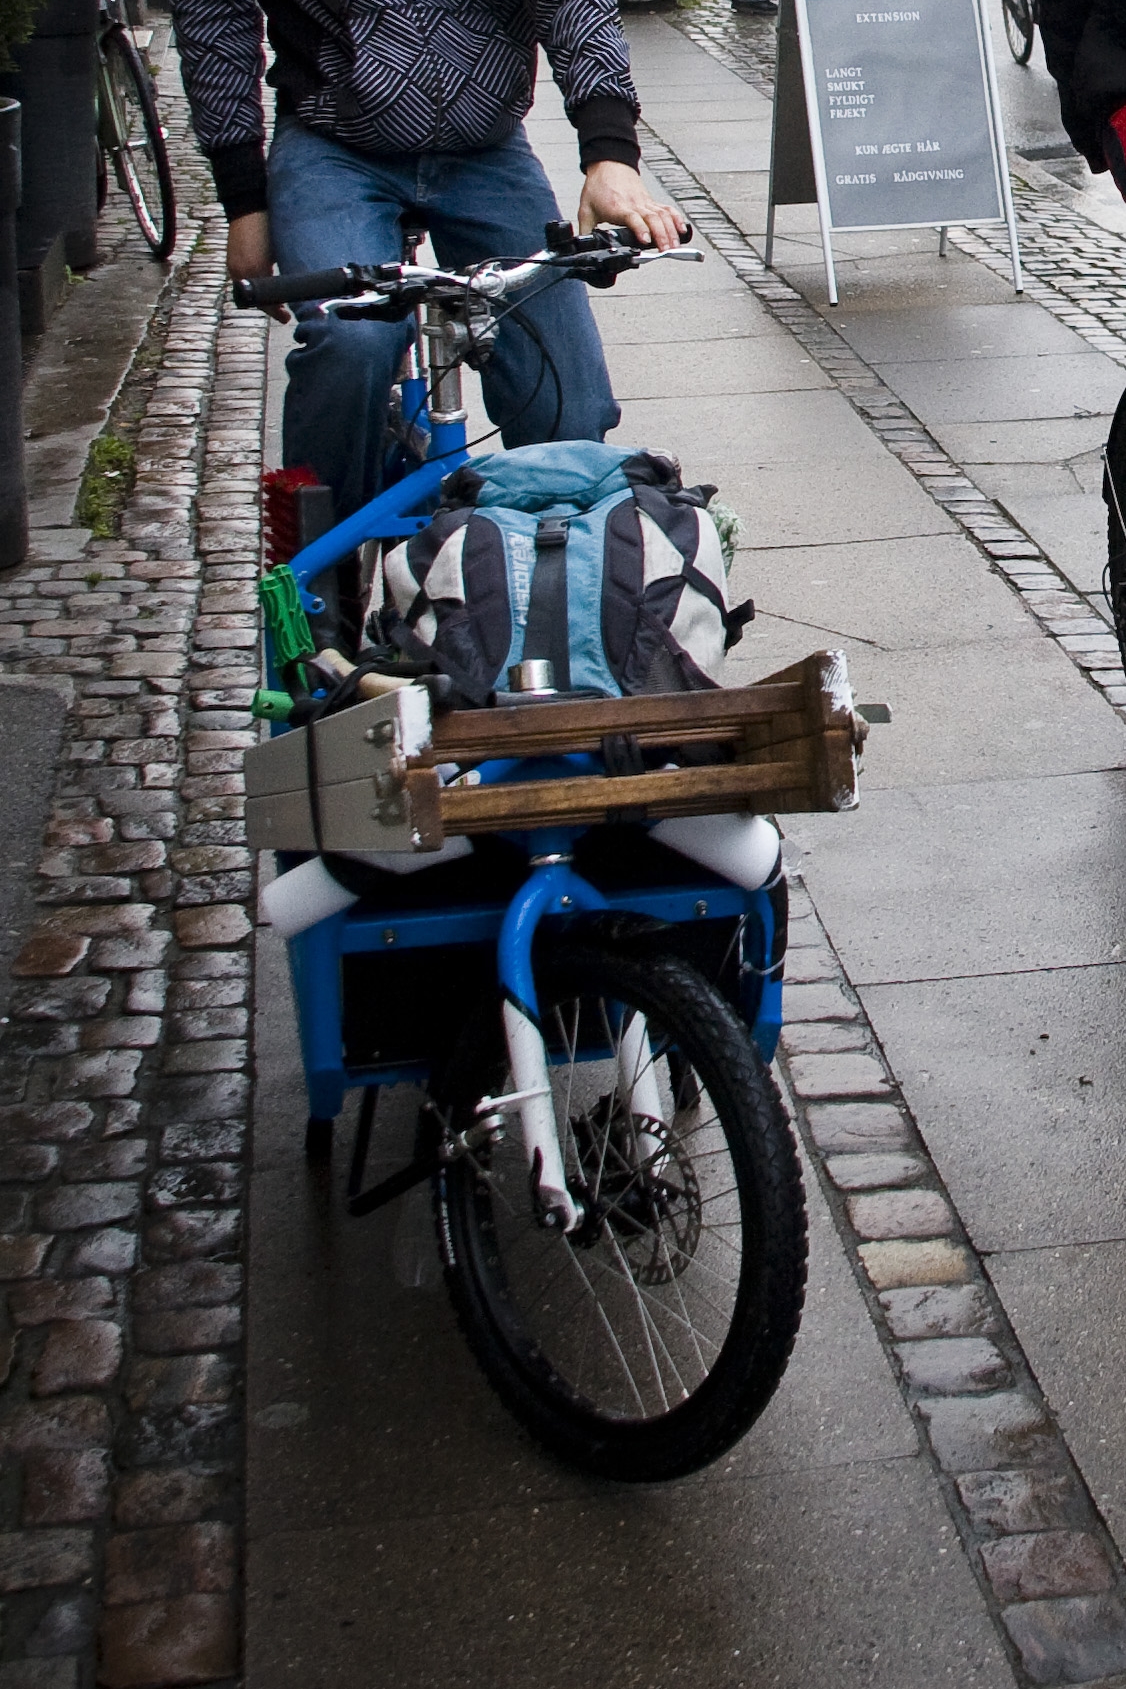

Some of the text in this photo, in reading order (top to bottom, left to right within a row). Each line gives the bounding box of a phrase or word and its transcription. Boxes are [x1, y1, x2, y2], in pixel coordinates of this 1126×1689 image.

[856, 10, 920, 23] EXTENSION
[825, 67, 862, 78] LANGT
[827, 81, 865, 92] SMUKT
[829, 94, 875, 106] FYLDIGT
[855, 144, 878, 155] KUN
[916, 140, 941, 153] HÅR
[835, 168, 964, 185] GRATIS RÅDGIVNING
